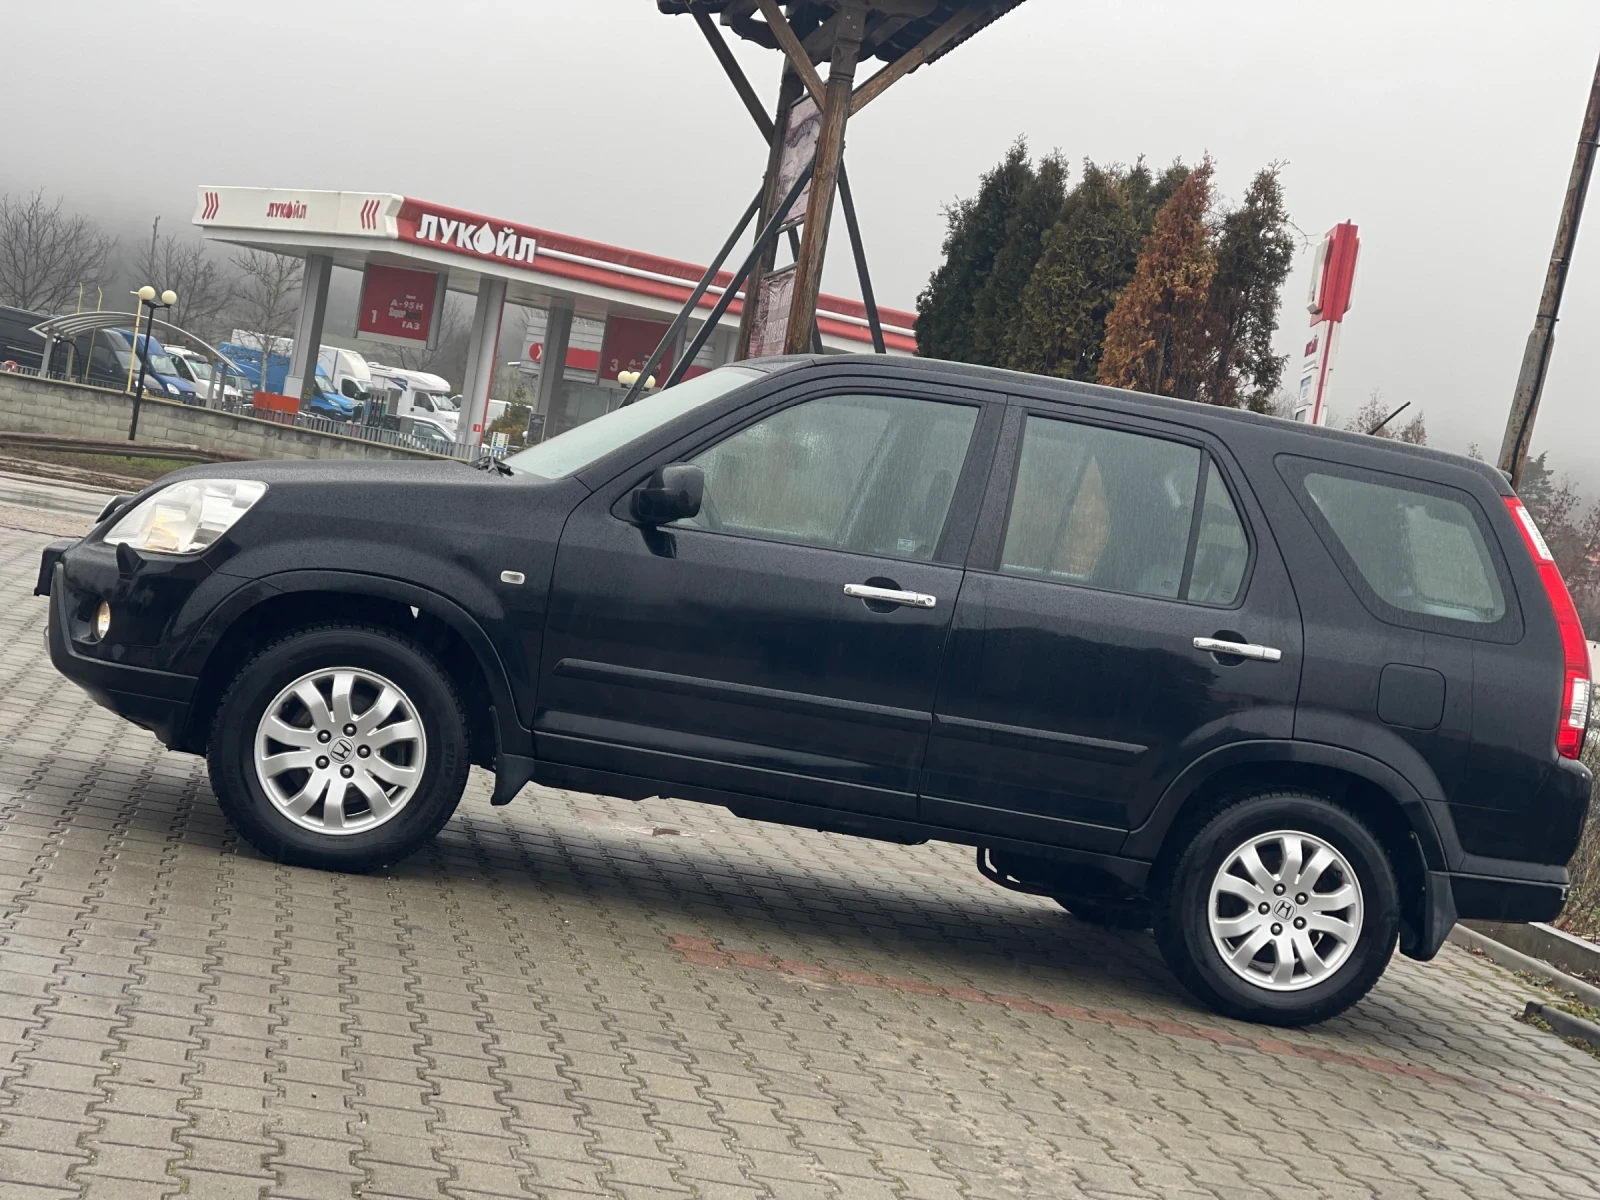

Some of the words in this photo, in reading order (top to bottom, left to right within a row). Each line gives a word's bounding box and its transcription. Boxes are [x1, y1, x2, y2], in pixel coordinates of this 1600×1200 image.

[371, 309, 378, 324] 1
[402, 321, 420, 330] ГАЗ
[609, 358, 619, 372] 3
